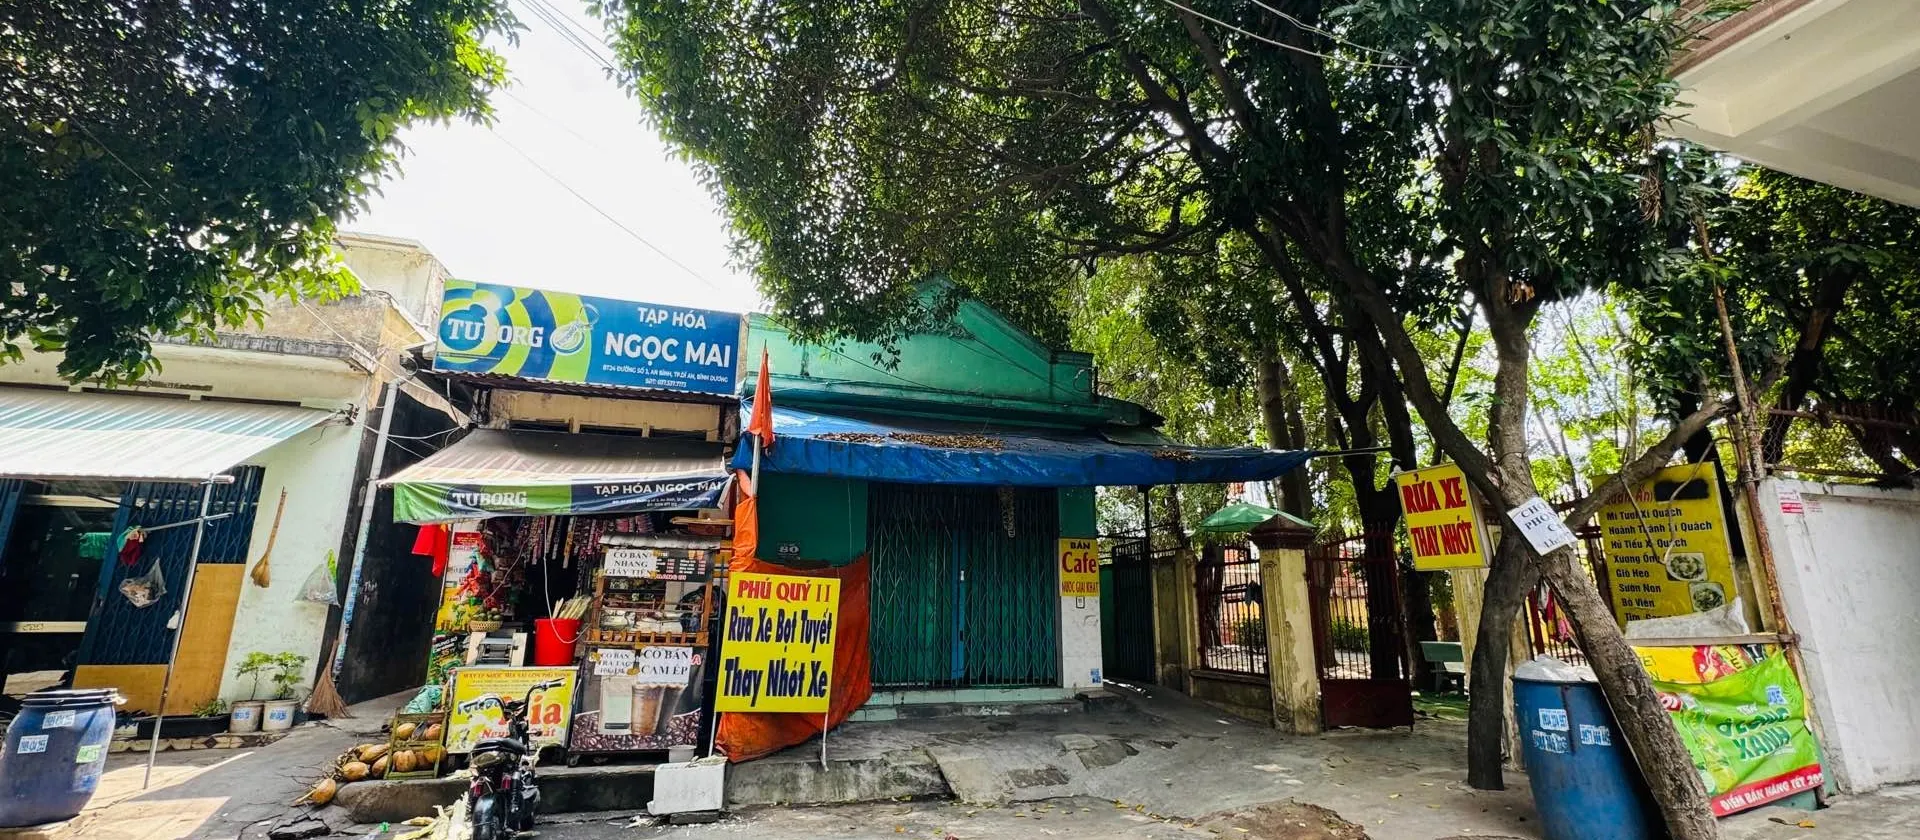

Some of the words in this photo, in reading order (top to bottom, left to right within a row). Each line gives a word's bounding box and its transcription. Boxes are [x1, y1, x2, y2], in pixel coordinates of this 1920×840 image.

[637, 307, 669, 327] TẠP
[671, 310, 707, 330] HÓA
[448, 318, 544, 348] TUORG
[604, 331, 679, 366] NGỌC
[684, 340, 731, 368] MAI
[452, 491, 528, 508] TUBORG
[593, 485, 619, 497] TẠP
[622, 482, 652, 494] HÓA
[655, 482, 695, 494] NGỌC
[697, 480, 721, 491] MAI
[1401, 474, 1441, 514] RỬA
[1439, 476, 1467, 510] XE
[1411, 526, 1441, 558] THAY
[1438, 516, 1477, 556] NHỚT
[1680, 520, 1712, 532] Quách
[614, 560, 648, 568] NHANG
[1062, 551, 1097, 574] Cafe
[1633, 569, 1650, 578] Heo
[737, 577, 772, 600] PHÚ
[776, 579, 811, 603] QUÝ
[1643, 584, 1661, 593] Non
[728, 605, 754, 642] Rửa
[755, 607, 773, 643] Xe
[775, 608, 797, 653] Bọt
[799, 607, 833, 654] Tuyết
[641, 665, 670, 675] CAM
[724, 656, 764, 707] Thay
[765, 658, 806, 698] Nhớt
[807, 660, 828, 698] Xe
[1731, 725, 1792, 761] XANH
